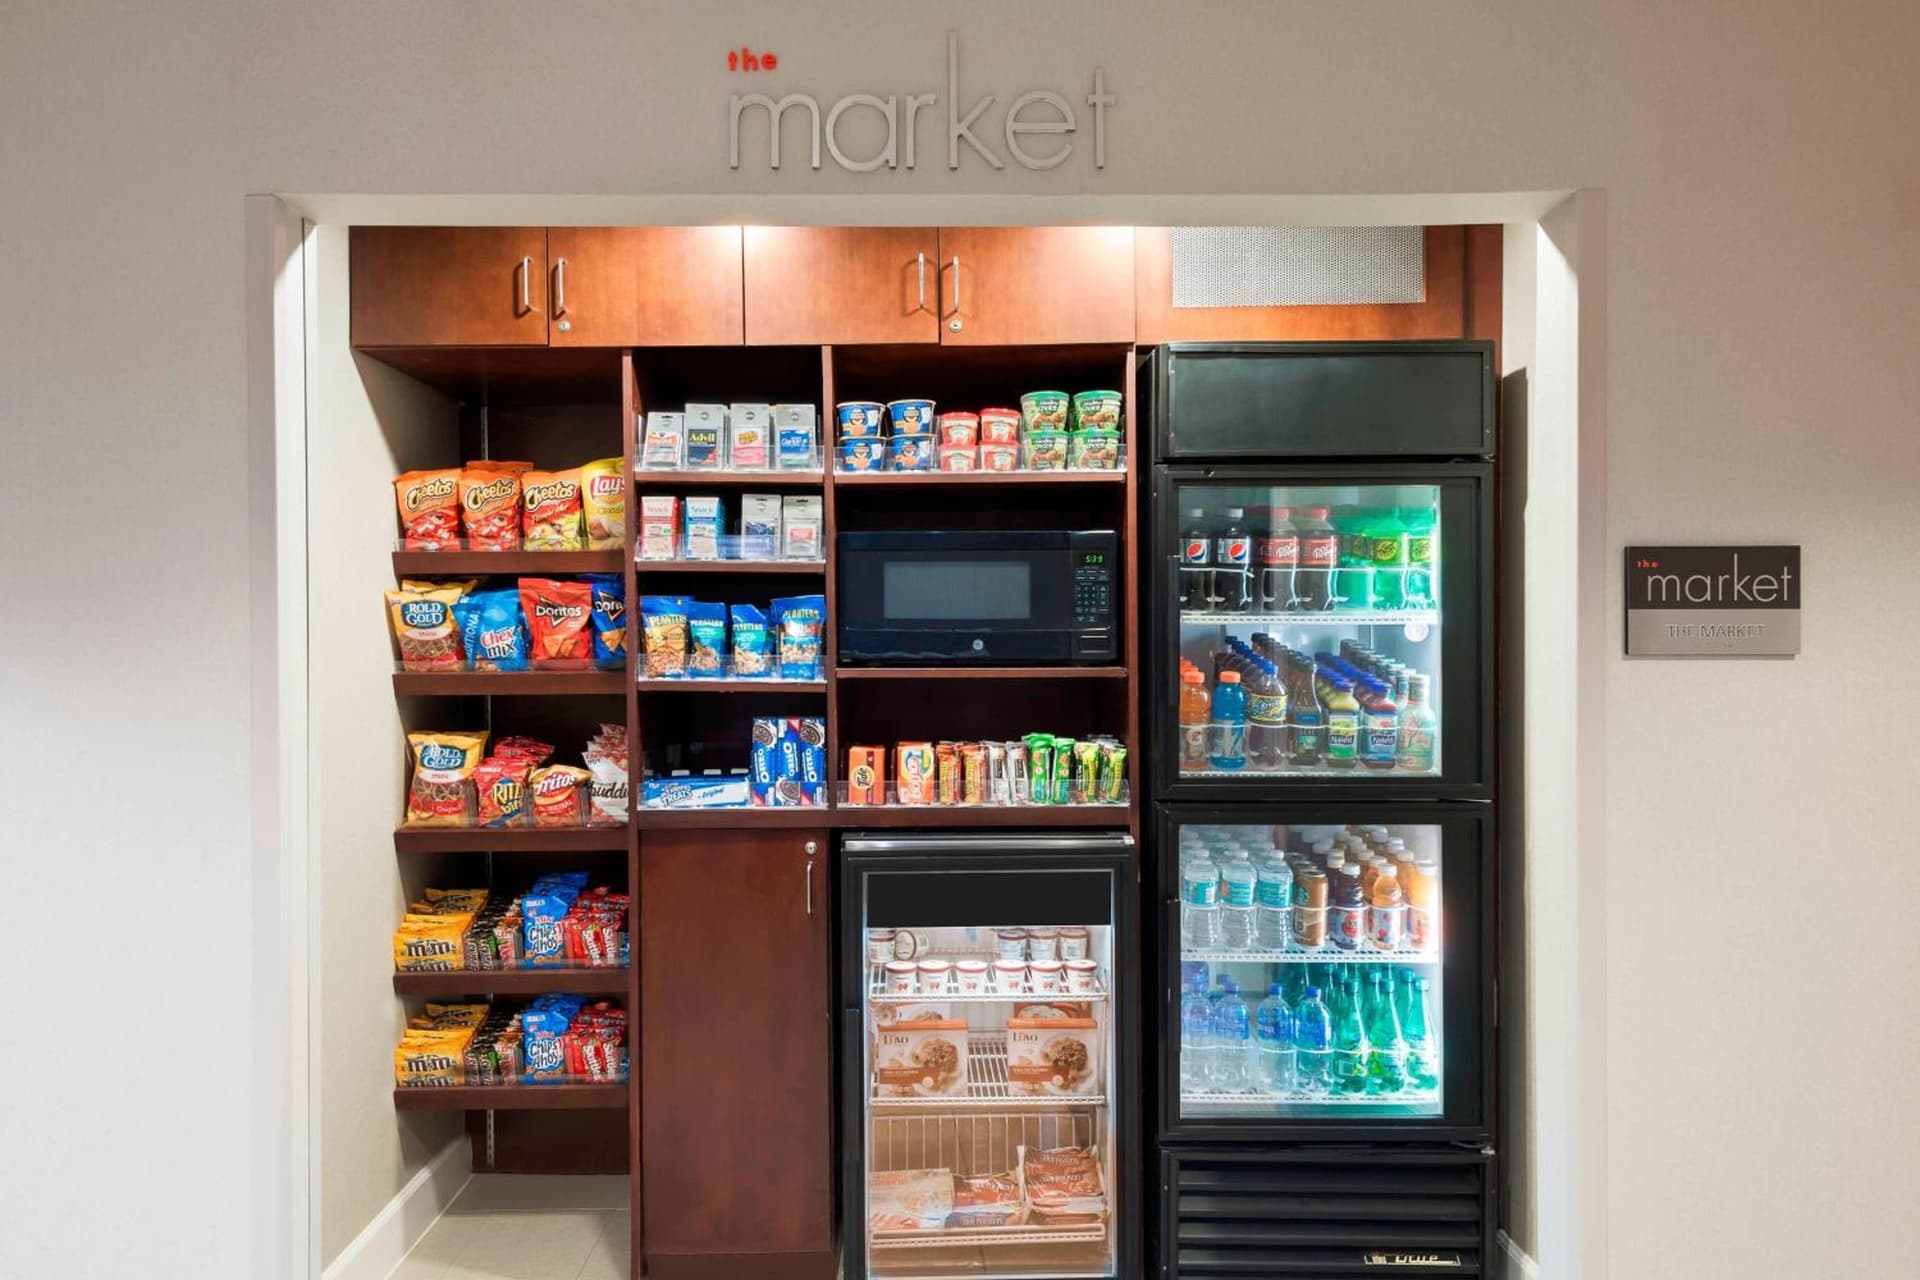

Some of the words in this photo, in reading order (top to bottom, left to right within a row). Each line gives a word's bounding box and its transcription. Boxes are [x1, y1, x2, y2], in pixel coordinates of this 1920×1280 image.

[728, 46, 777, 71] the
[730, 31, 1116, 171] market
[689, 432, 715, 442] Advil
[407, 479, 453, 511] Cheetos
[466, 479, 513, 511] Cheetos
[526, 481, 575, 511] Cheetos
[1637, 560, 1658, 568] the
[1648, 553, 1792, 602] market
[409, 602, 441, 613] ROLD
[536, 605, 582, 616] Doritos
[406, 612, 444, 625] GOLD
[480, 627, 515, 648] Chex
[1664, 624, 1695, 638] THE
[1699, 624, 1767, 639] MARKET
[487, 642, 516, 658] mix
[423, 755, 461, 768] GOLD
[429, 747, 461, 758] ROLD
[783, 742, 795, 776] OREO
[757, 748, 769, 783] OREO
[806, 748, 817, 783] OREO
[855, 767, 870, 787] Tide
[493, 783, 523, 804] RITZ
